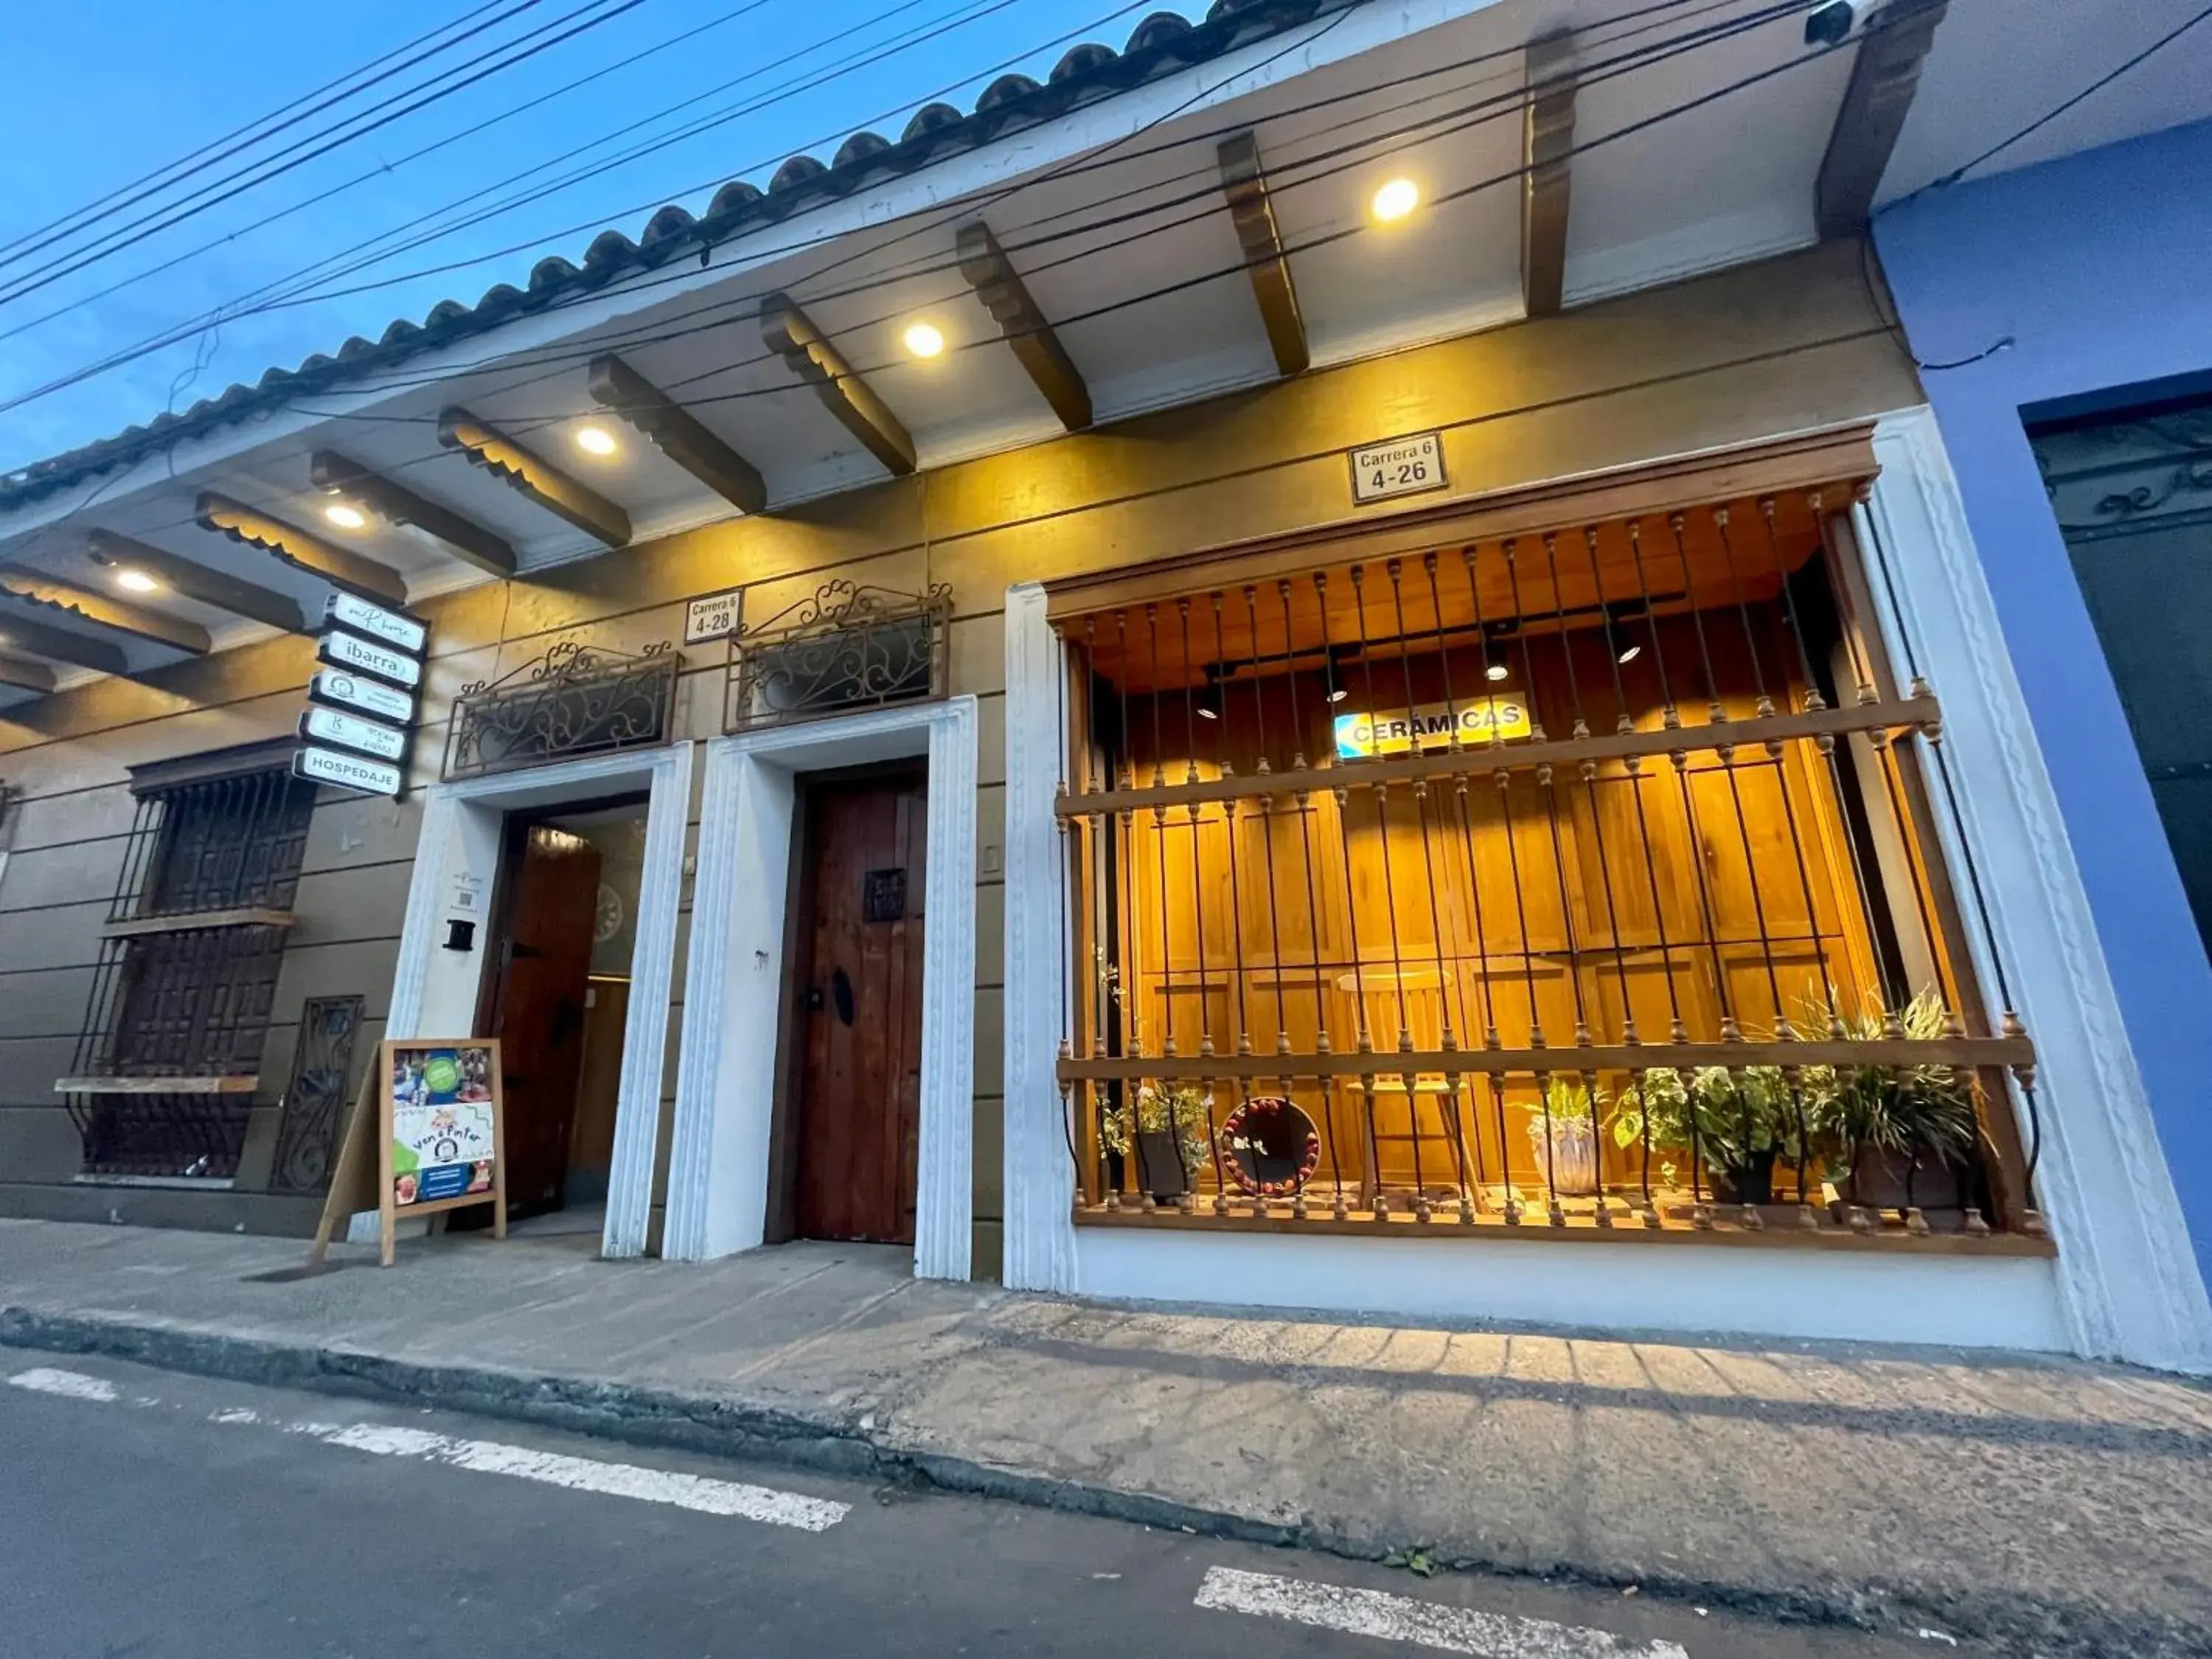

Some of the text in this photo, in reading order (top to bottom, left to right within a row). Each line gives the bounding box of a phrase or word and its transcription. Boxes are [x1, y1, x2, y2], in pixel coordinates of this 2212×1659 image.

[1360, 441, 1433, 467] Carrera 6
[1371, 461, 1427, 489] 4-26
[692, 600, 728, 616] Carrera
[695, 613, 730, 634] 4-28
[347, 641, 398, 671] ibarra
[312, 757, 394, 785] HOSPEDAJE
